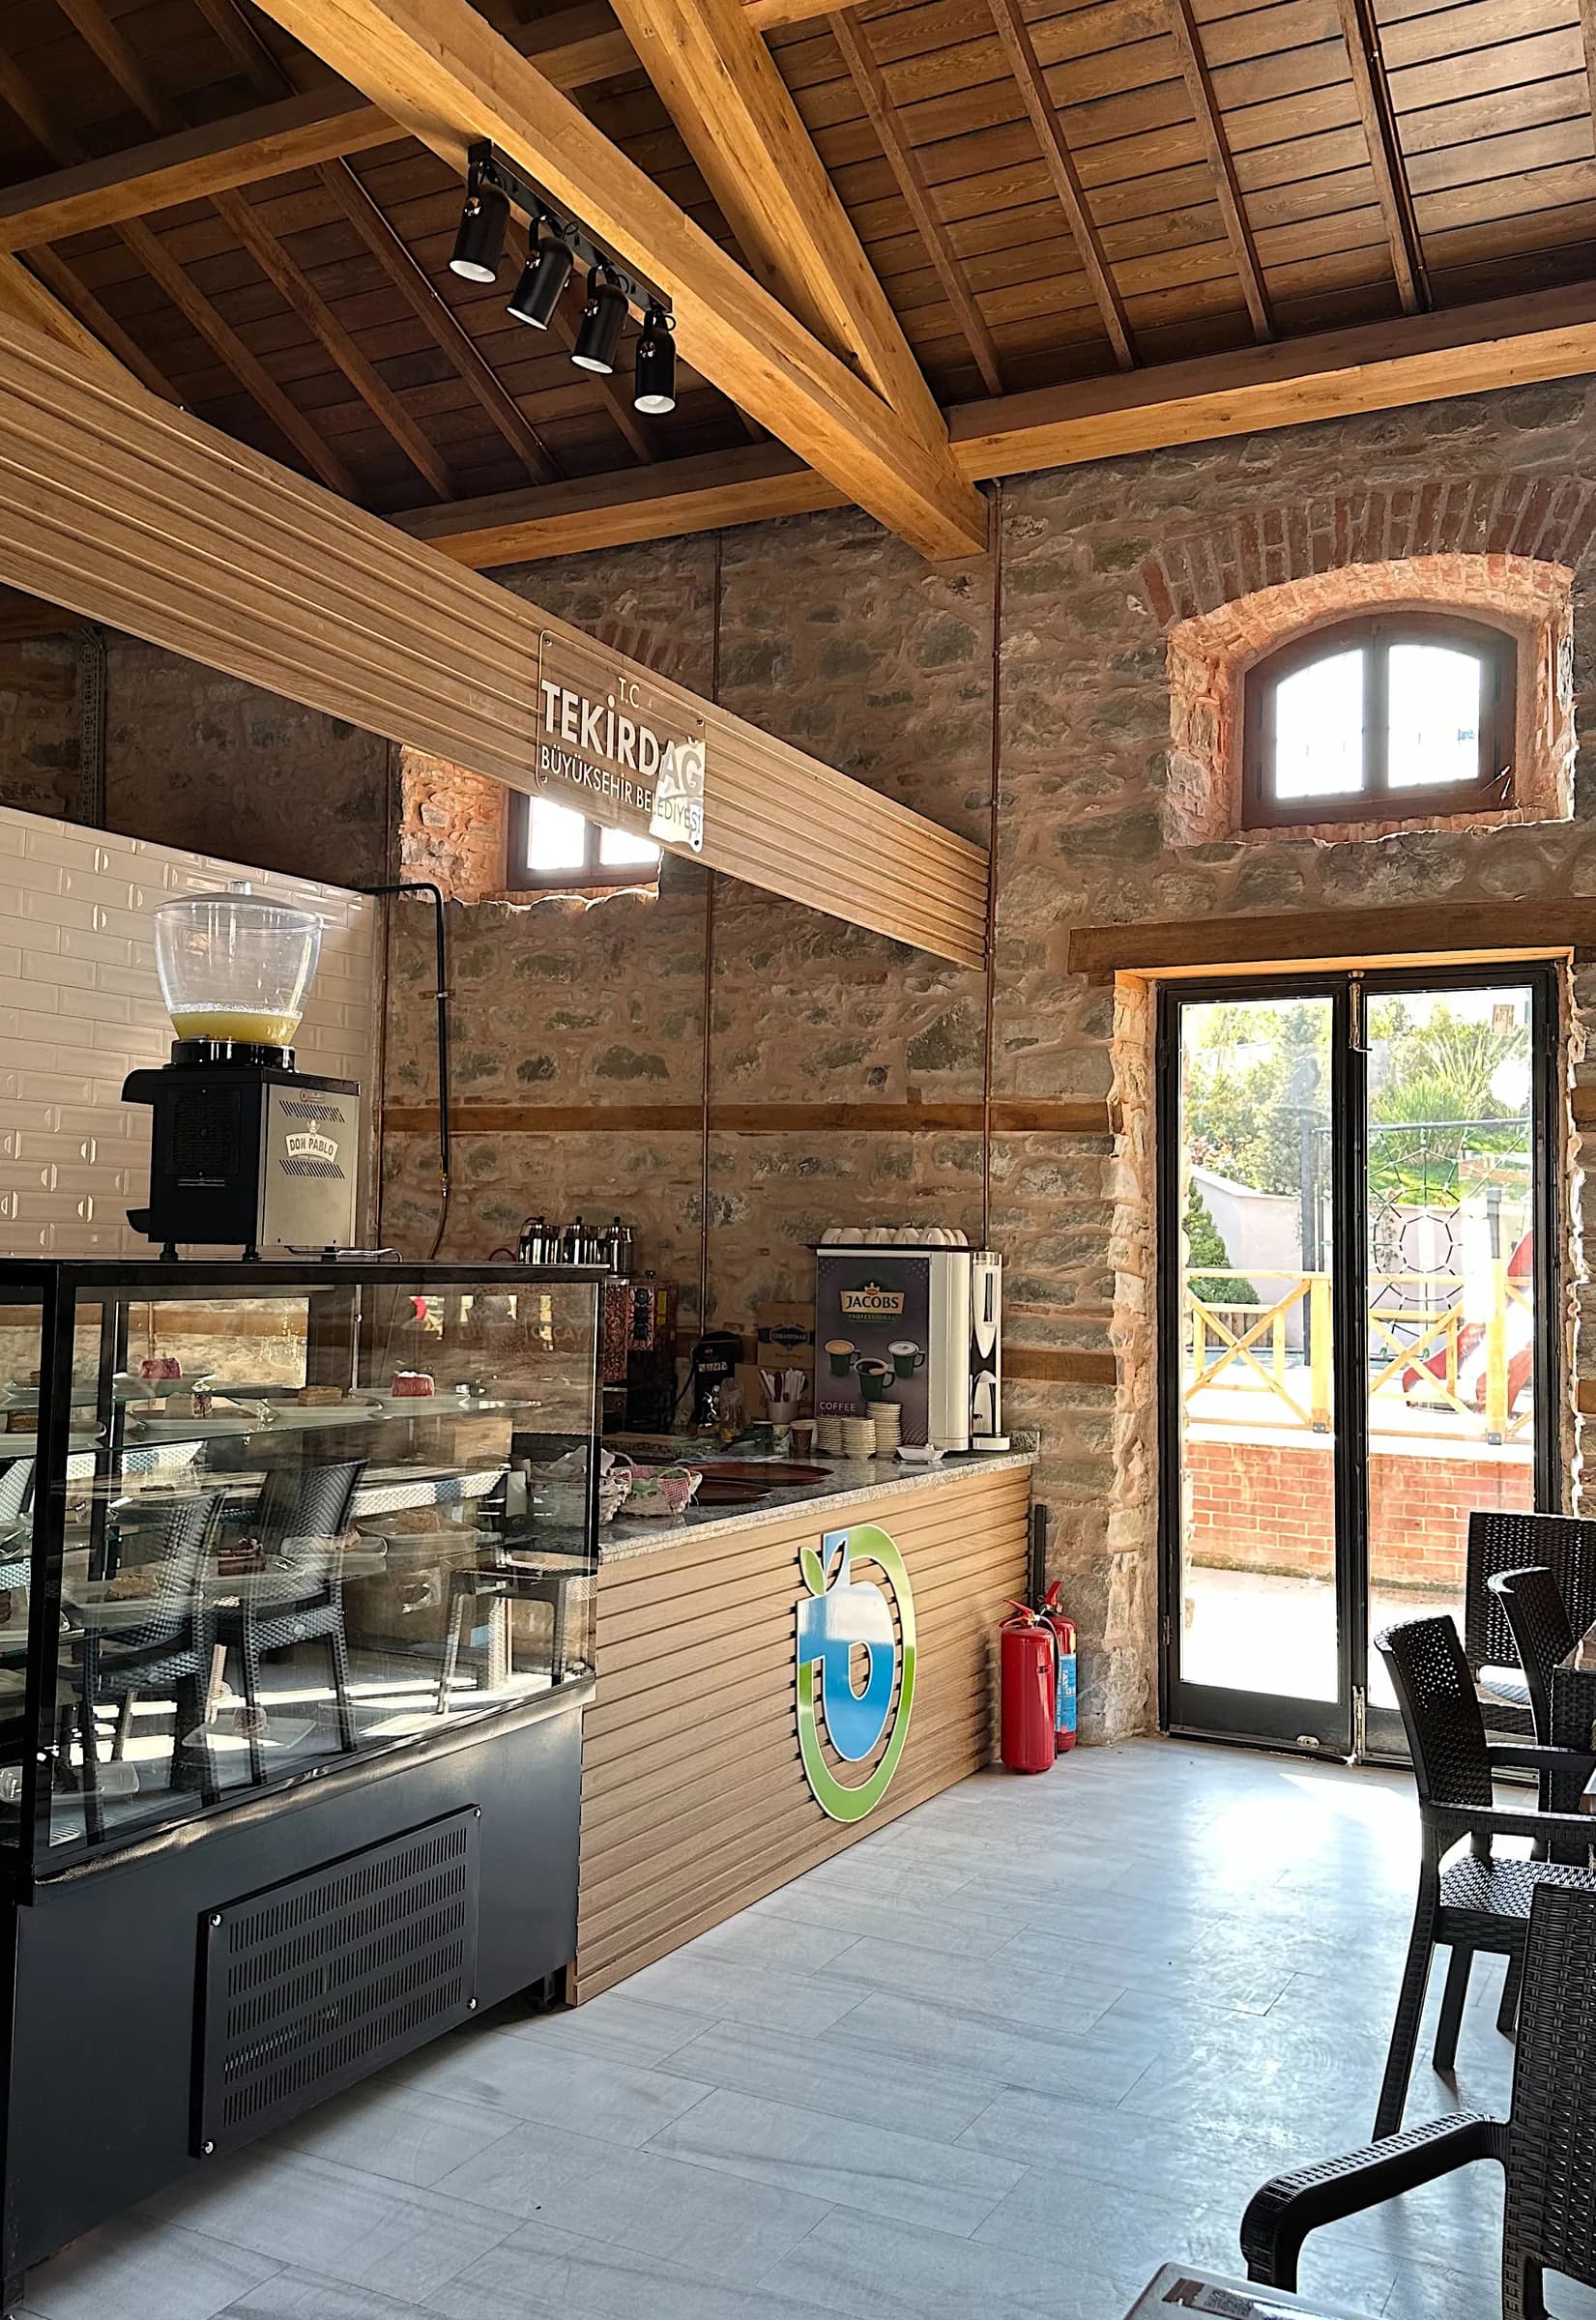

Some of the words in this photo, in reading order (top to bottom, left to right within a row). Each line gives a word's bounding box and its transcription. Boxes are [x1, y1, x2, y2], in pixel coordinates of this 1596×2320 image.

[540, 678, 703, 799] TEKİRDAĞ
[636, 785, 702, 834] BELEDİYESİ
[289, 1137, 306, 1151] DON
[308, 1138, 334, 1156] PABLO
[845, 1295, 899, 1309] JACOBS
[819, 1401, 856, 1412] COFFEE
